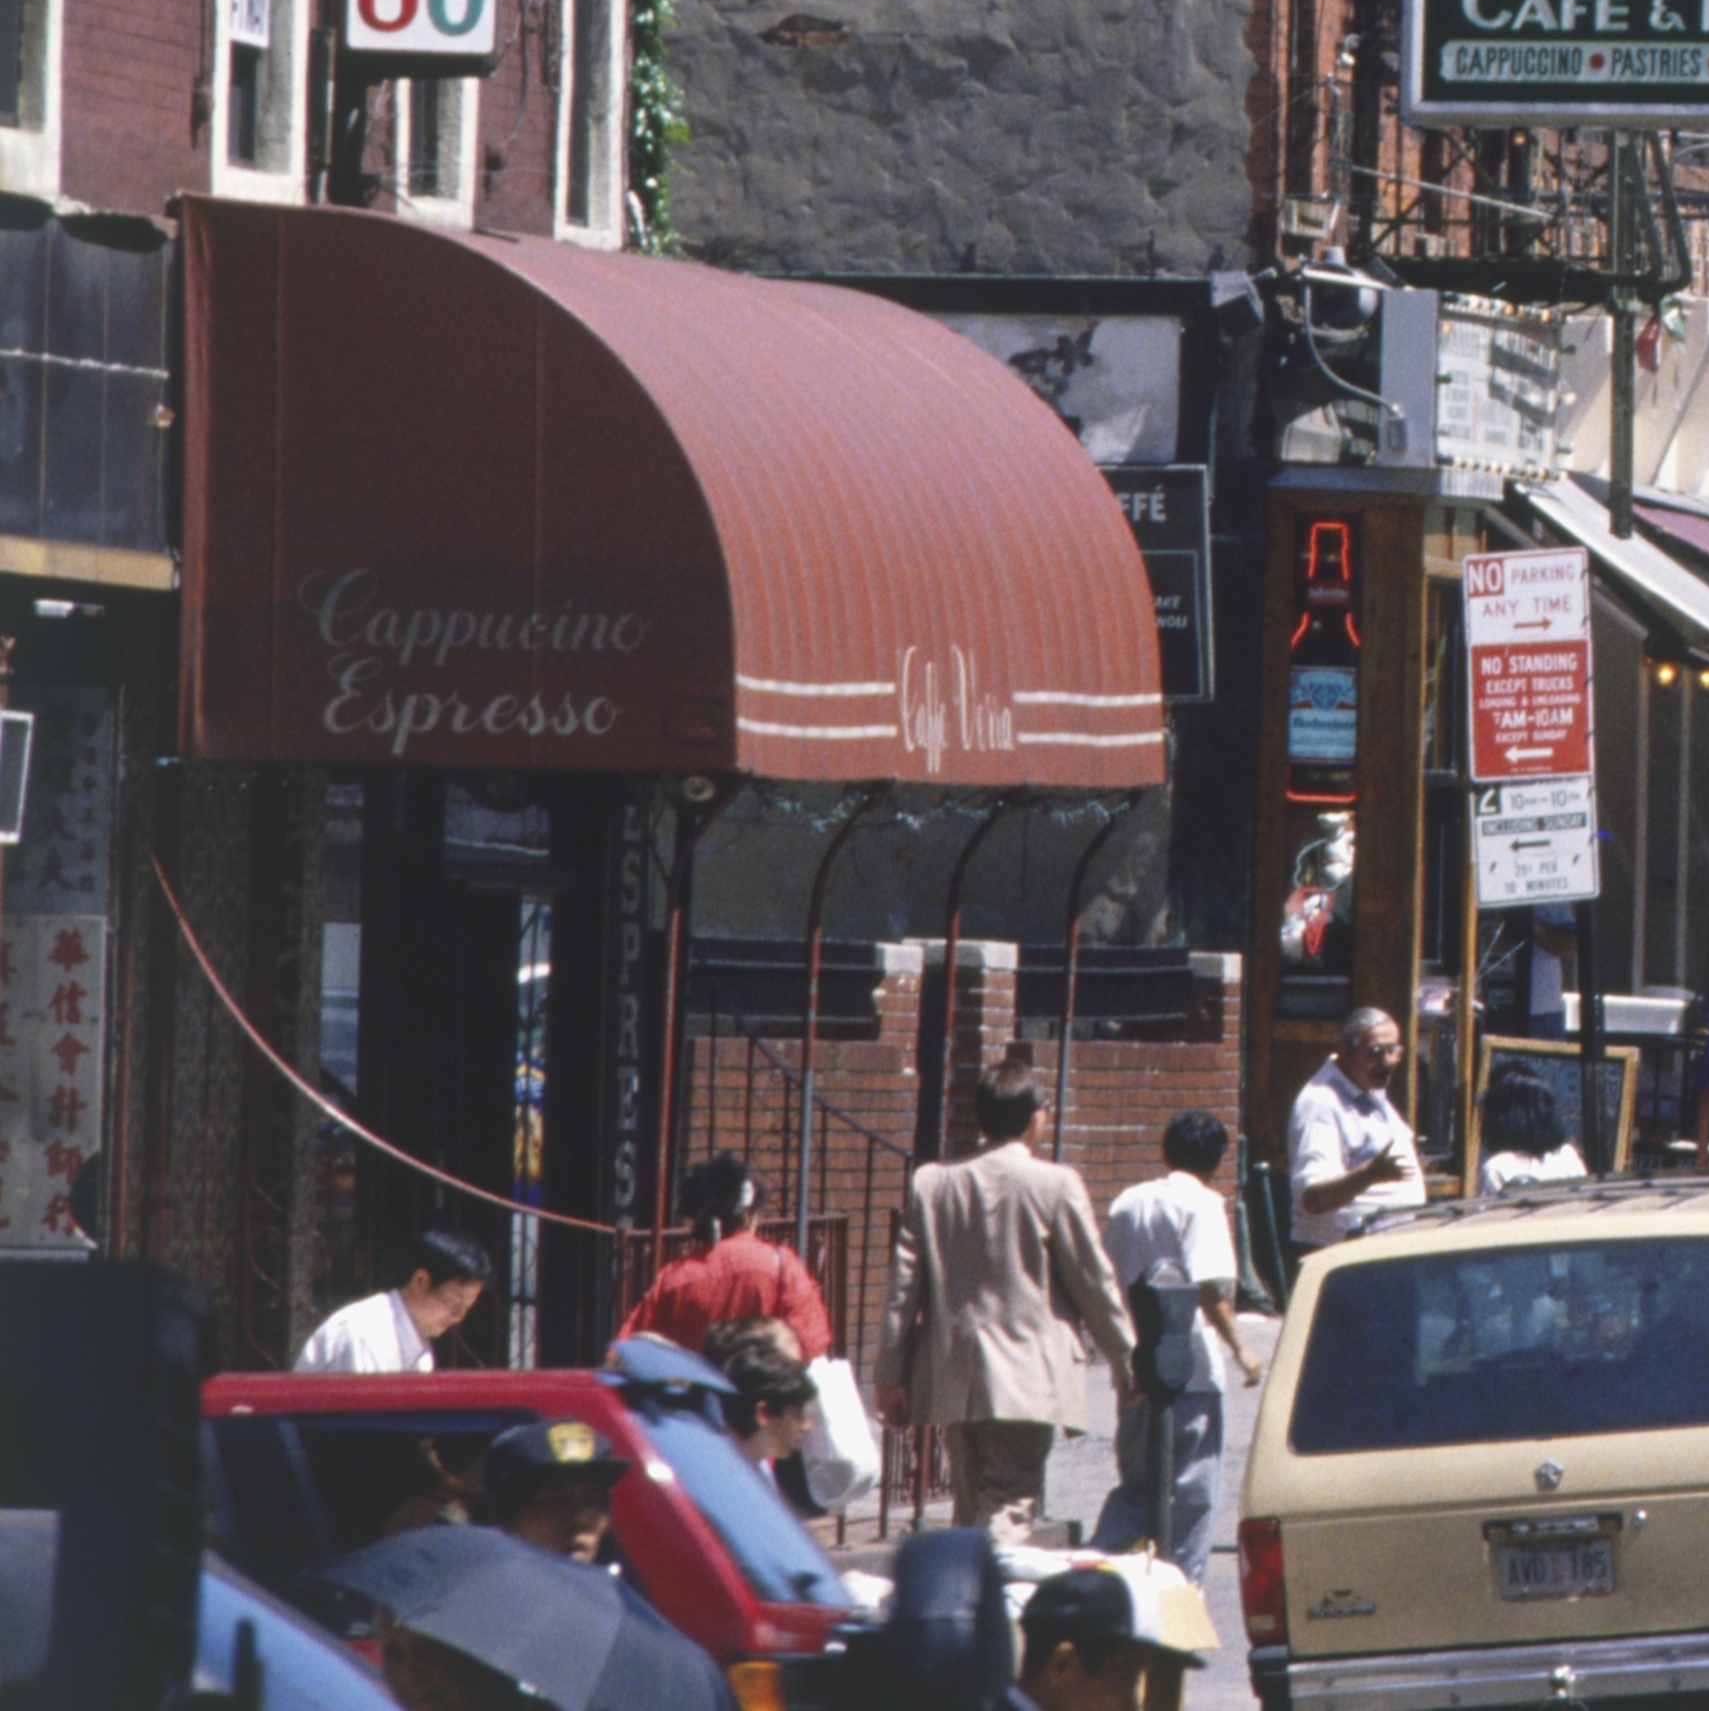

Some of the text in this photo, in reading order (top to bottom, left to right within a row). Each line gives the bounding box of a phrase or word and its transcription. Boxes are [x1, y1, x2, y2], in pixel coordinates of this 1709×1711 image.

[1454, 48, 1585, 79] CAPPUCCINO
[1609, 48, 1703, 79] PASTRIES
[1468, 562, 1575, 594] NO PARKING
[1482, 596, 1572, 618] ANY TIME
[1481, 652, 1578, 675] NO STANDING
[1486, 675, 1574, 694] EXCEPT TRUCKS
[324, 651, 624, 755] Espresso
